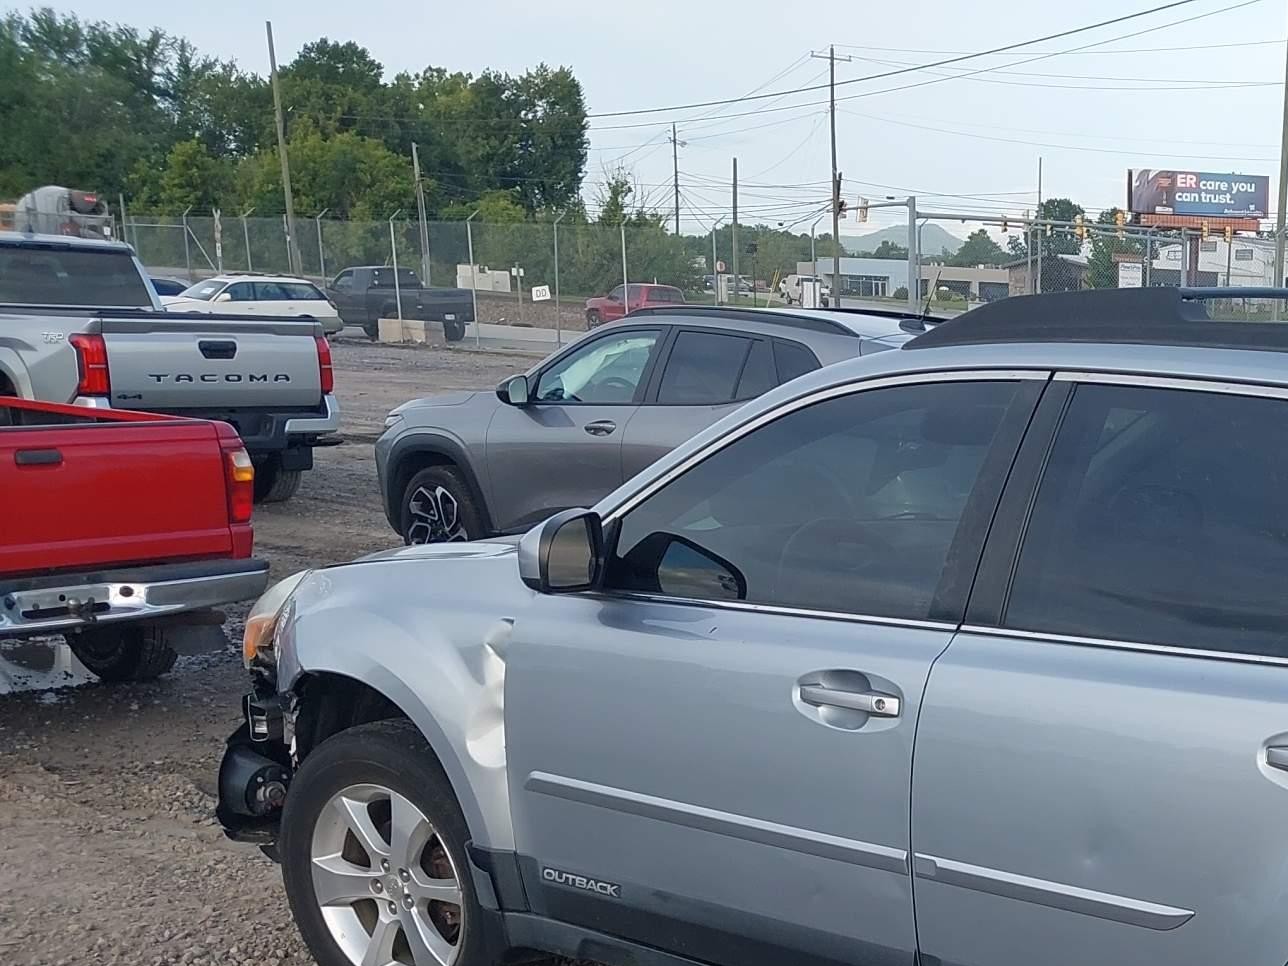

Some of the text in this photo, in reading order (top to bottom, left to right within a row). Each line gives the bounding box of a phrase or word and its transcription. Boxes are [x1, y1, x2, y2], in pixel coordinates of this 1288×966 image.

[1176, 173, 1256, 194] ER care you
[1175, 191, 1235, 205] can trust.
[148, 373, 292, 384] TACOMA
[543, 868, 619, 898] OUTBACK
